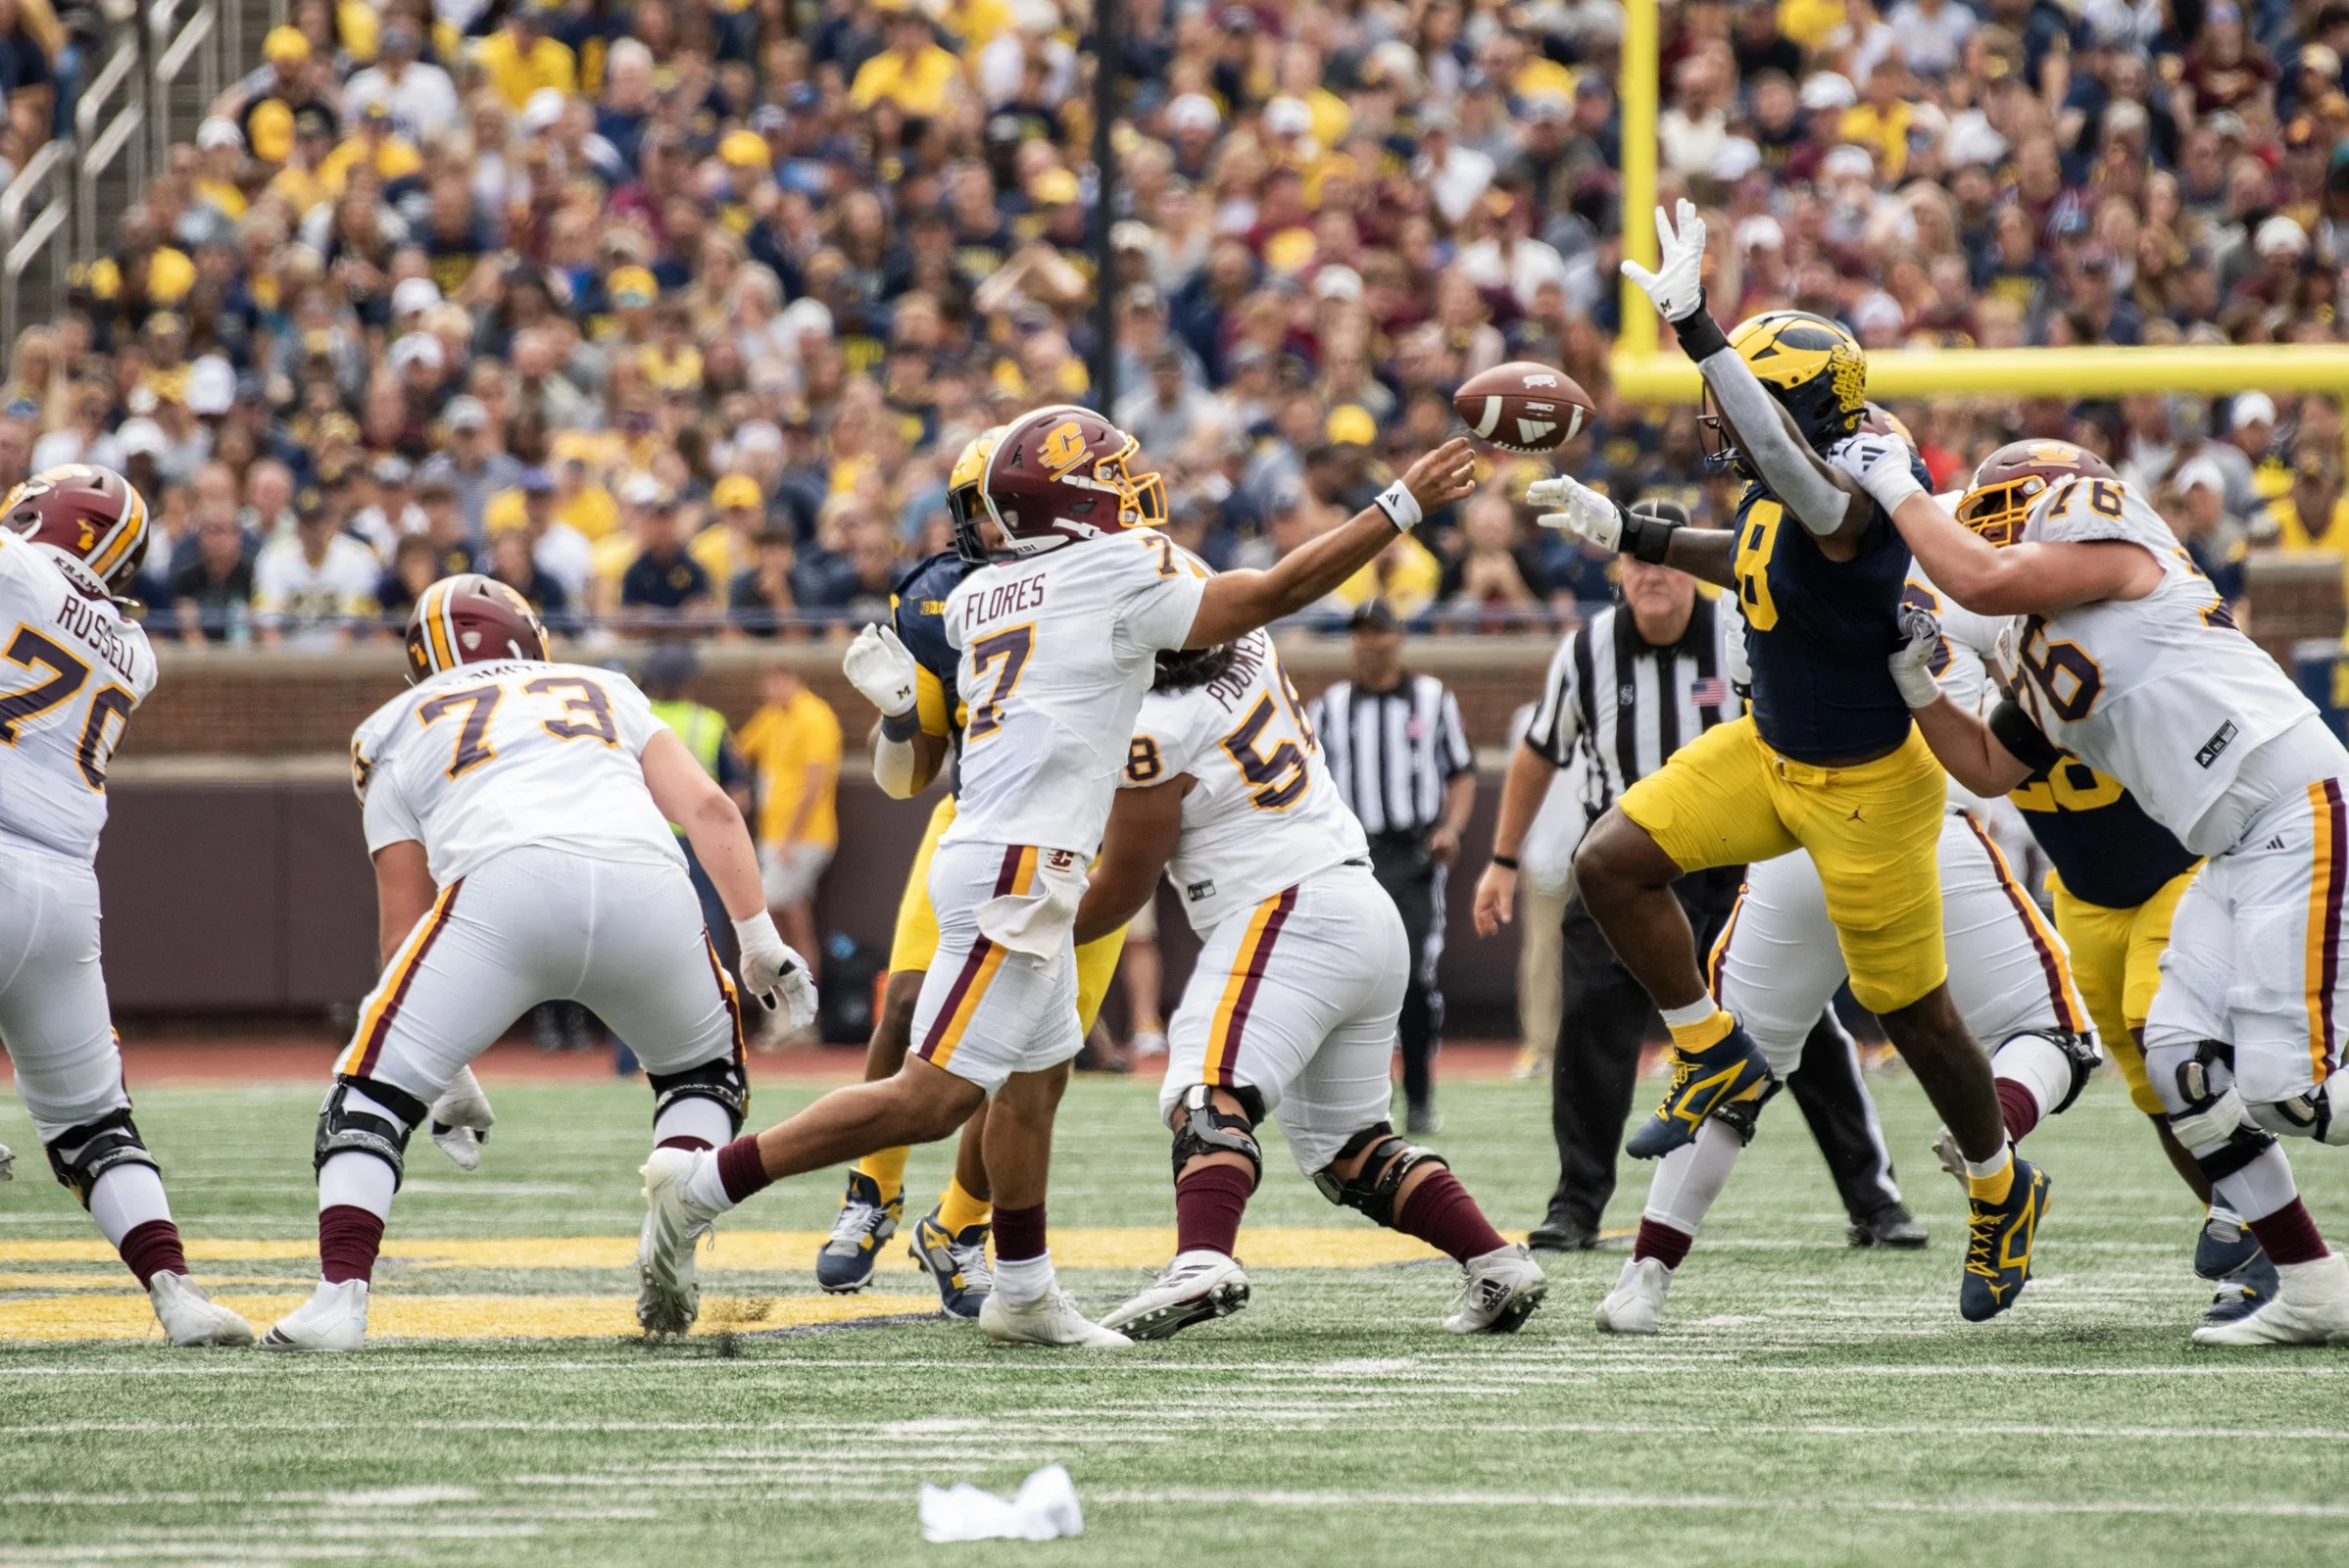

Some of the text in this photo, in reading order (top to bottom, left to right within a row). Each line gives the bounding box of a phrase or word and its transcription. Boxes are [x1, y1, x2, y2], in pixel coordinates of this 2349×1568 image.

[2047, 477, 2127, 520] 76
[1138, 534, 1179, 579] 7
[1734, 499, 1784, 632] 8
[965, 572, 1047, 630] FLORES
[57, 594, 135, 684] RUSSELL
[0, 620, 138, 794] 70
[897, 685, 912, 701] M
[965, 620, 1036, 745] 7
[415, 676, 621, 782] 73
[1485, 1284, 1511, 1312] adidas
